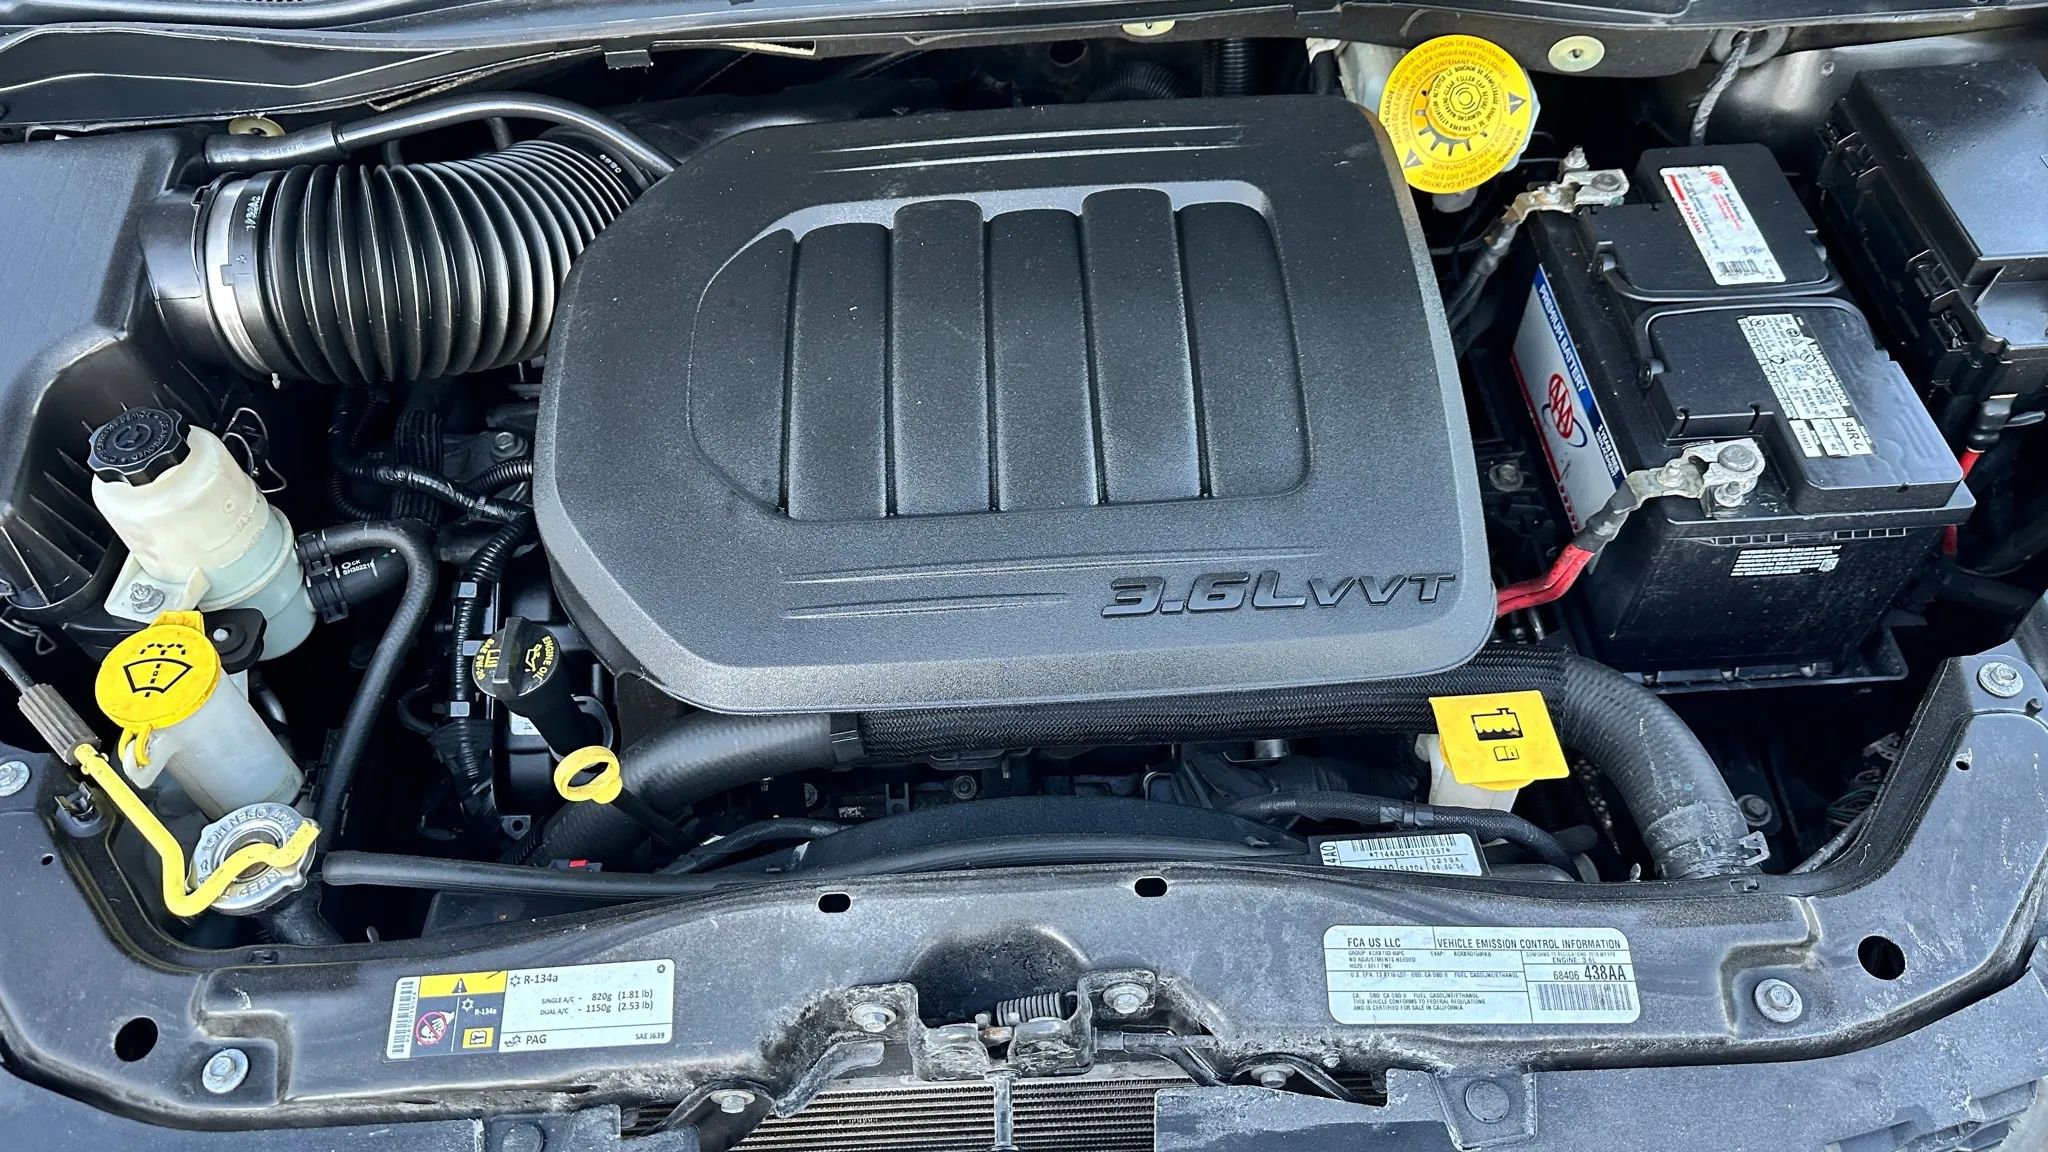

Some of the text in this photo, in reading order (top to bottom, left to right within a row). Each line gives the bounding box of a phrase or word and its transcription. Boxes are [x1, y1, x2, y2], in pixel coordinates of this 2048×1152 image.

[1539, 283, 1587, 393] PREMIUM BATTERY
[1549, 376, 1573, 437] AAA
[532, 635, 555, 682] ENGINE OIL
[229, 807, 268, 827] OPEN
[1347, 938, 1401, 948] FCA US LLC
[1437, 939, 1621, 949] VEHICLE EMISSION CONTROL INFORMATION
[524, 973, 558, 984] R-134a
[1553, 965, 1627, 981] 68406 438AA
[591, 992, 612, 1001] 820g
[618, 991, 639, 1000] (1.81
[641, 989, 653, 999] lb)
[474, 1008, 497, 1016] R-134a
[586, 1004, 611, 1013] 1150g
[618, 1002, 639, 1012] (2.53
[641, 1000, 653, 1010] lb)
[526, 1034, 547, 1044] PAG
